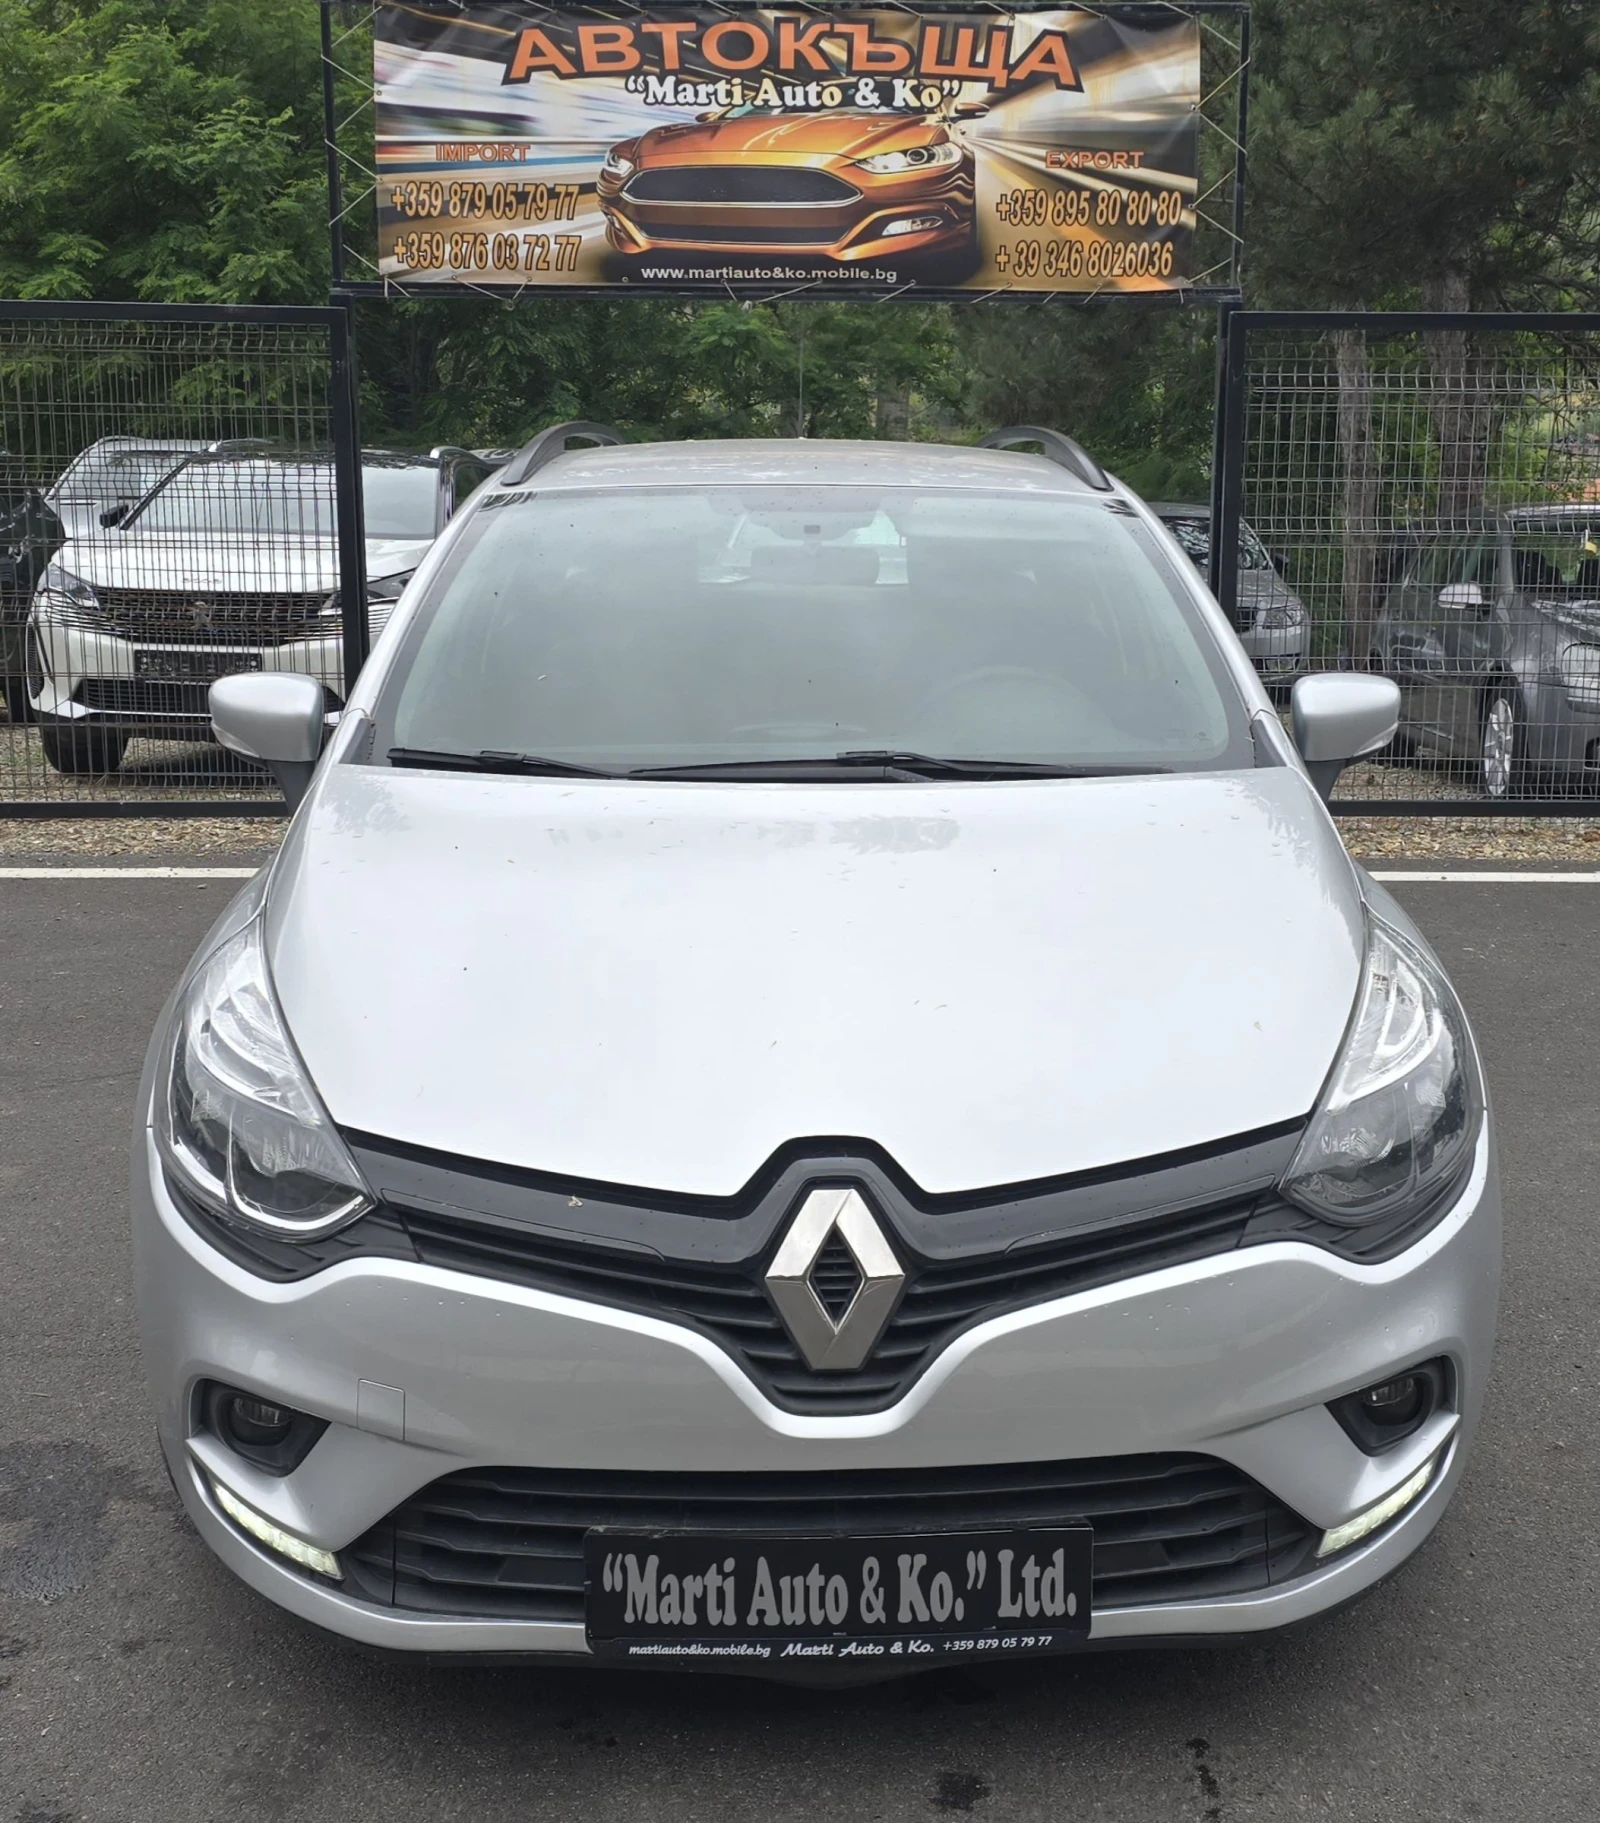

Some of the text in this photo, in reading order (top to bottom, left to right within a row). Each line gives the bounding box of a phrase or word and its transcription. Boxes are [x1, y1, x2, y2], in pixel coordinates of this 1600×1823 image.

[510, 22, 1077, 88] АВТОКЪЩА
[753, 77, 843, 107] Auto
[854, 77, 880, 107] &
[436, 144, 530, 162] IMPORT
[1046, 151, 1144, 168] EXPORT
[391, 181, 579, 220] +359 879 05 79 77
[996, 188, 1182, 226] +359 895 80 80 80
[394, 232, 582, 271] +359 876 03 72 77
[995, 240, 1174, 278] + 39 346 8026036
[641, 267, 897, 283] www.martiauto&ko.mobile.bg
[747, 1556, 849, 1627] Auto
[860, 1556, 886, 1624] &
[998, 1548, 1076, 1618] Ltd.
[629, 1636, 1052, 1657] martiauto&ko.mobile.bg Marti Auto & Ko. +359 879 05 79 77
